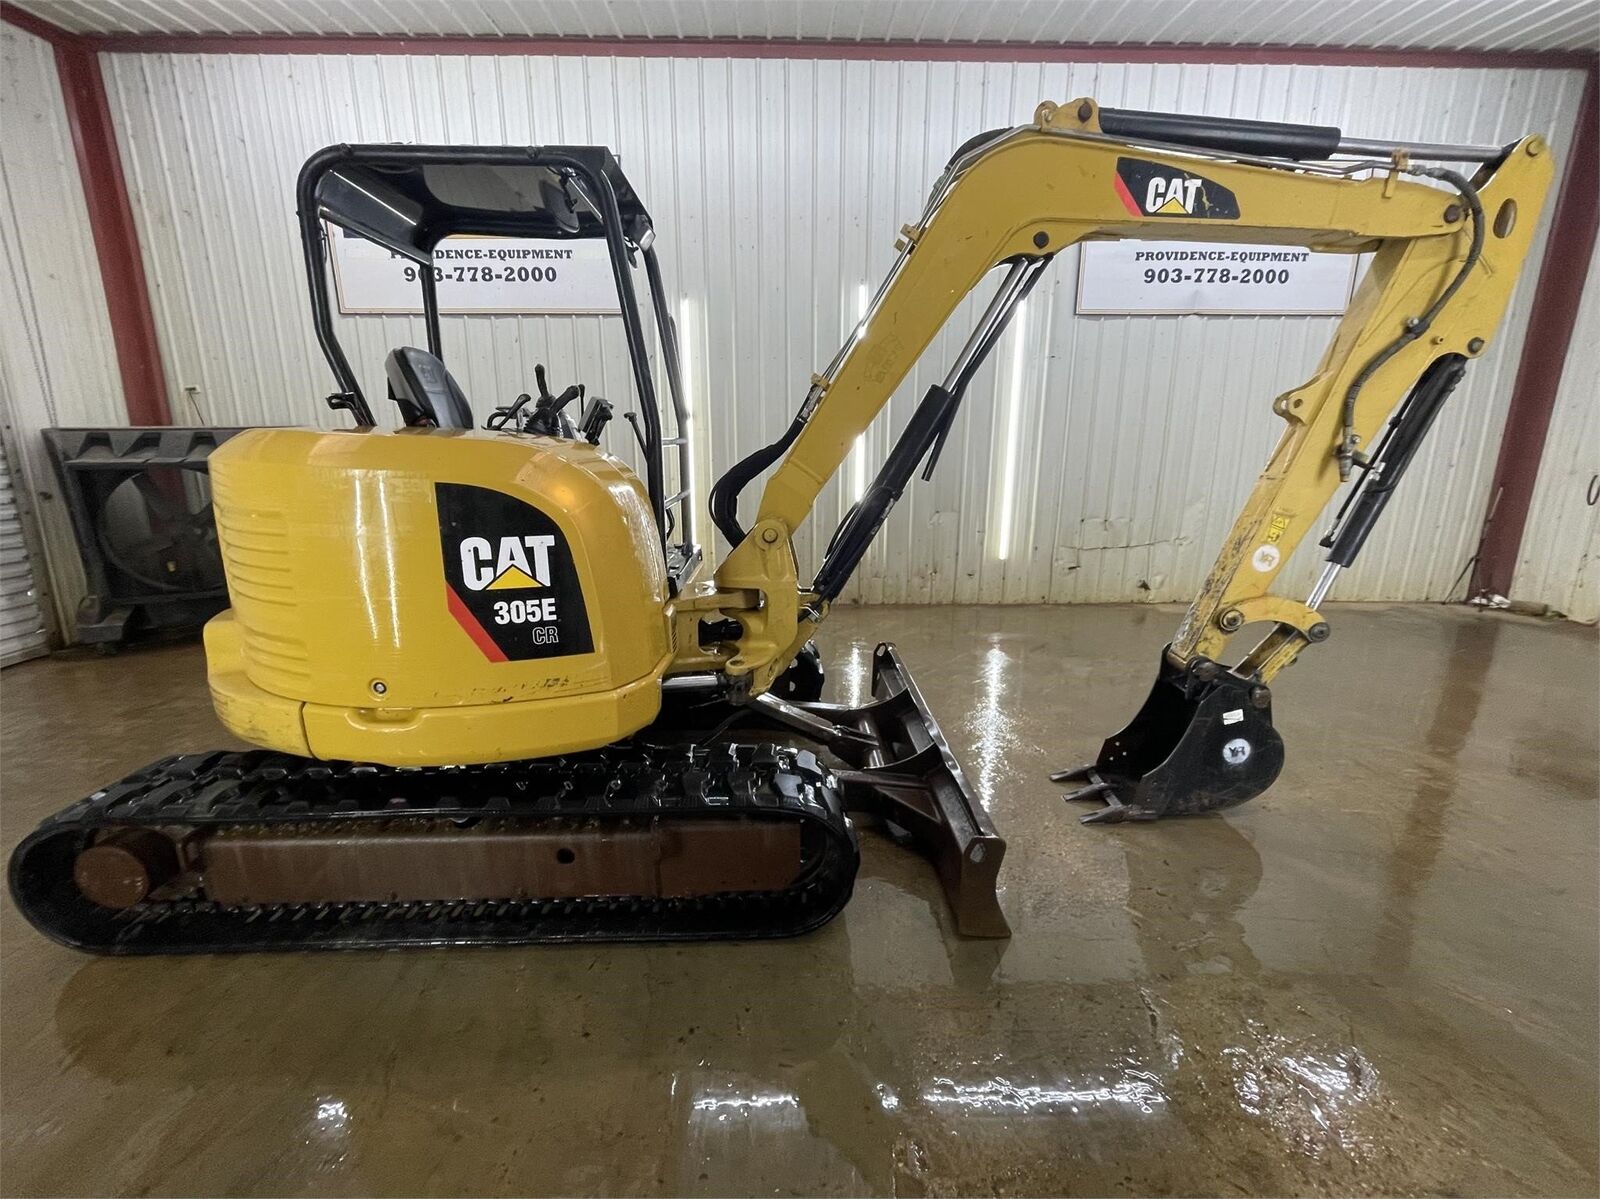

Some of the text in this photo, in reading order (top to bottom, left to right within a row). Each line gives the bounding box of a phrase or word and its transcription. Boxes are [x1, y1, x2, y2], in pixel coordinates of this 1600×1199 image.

[1145, 177, 1203, 215] CAT
[391, 249, 573, 260] DENCE-EQUIPMENT
[1135, 251, 1309, 263] PROVIDENCE-EQUIPMENT
[403, 266, 557, 282] 93-778-2000
[1143, 268, 1290, 284] 903-778-2000
[459, 535, 556, 591] CAT
[493, 598, 558, 625] 305E
[532, 626, 559, 645] CR
